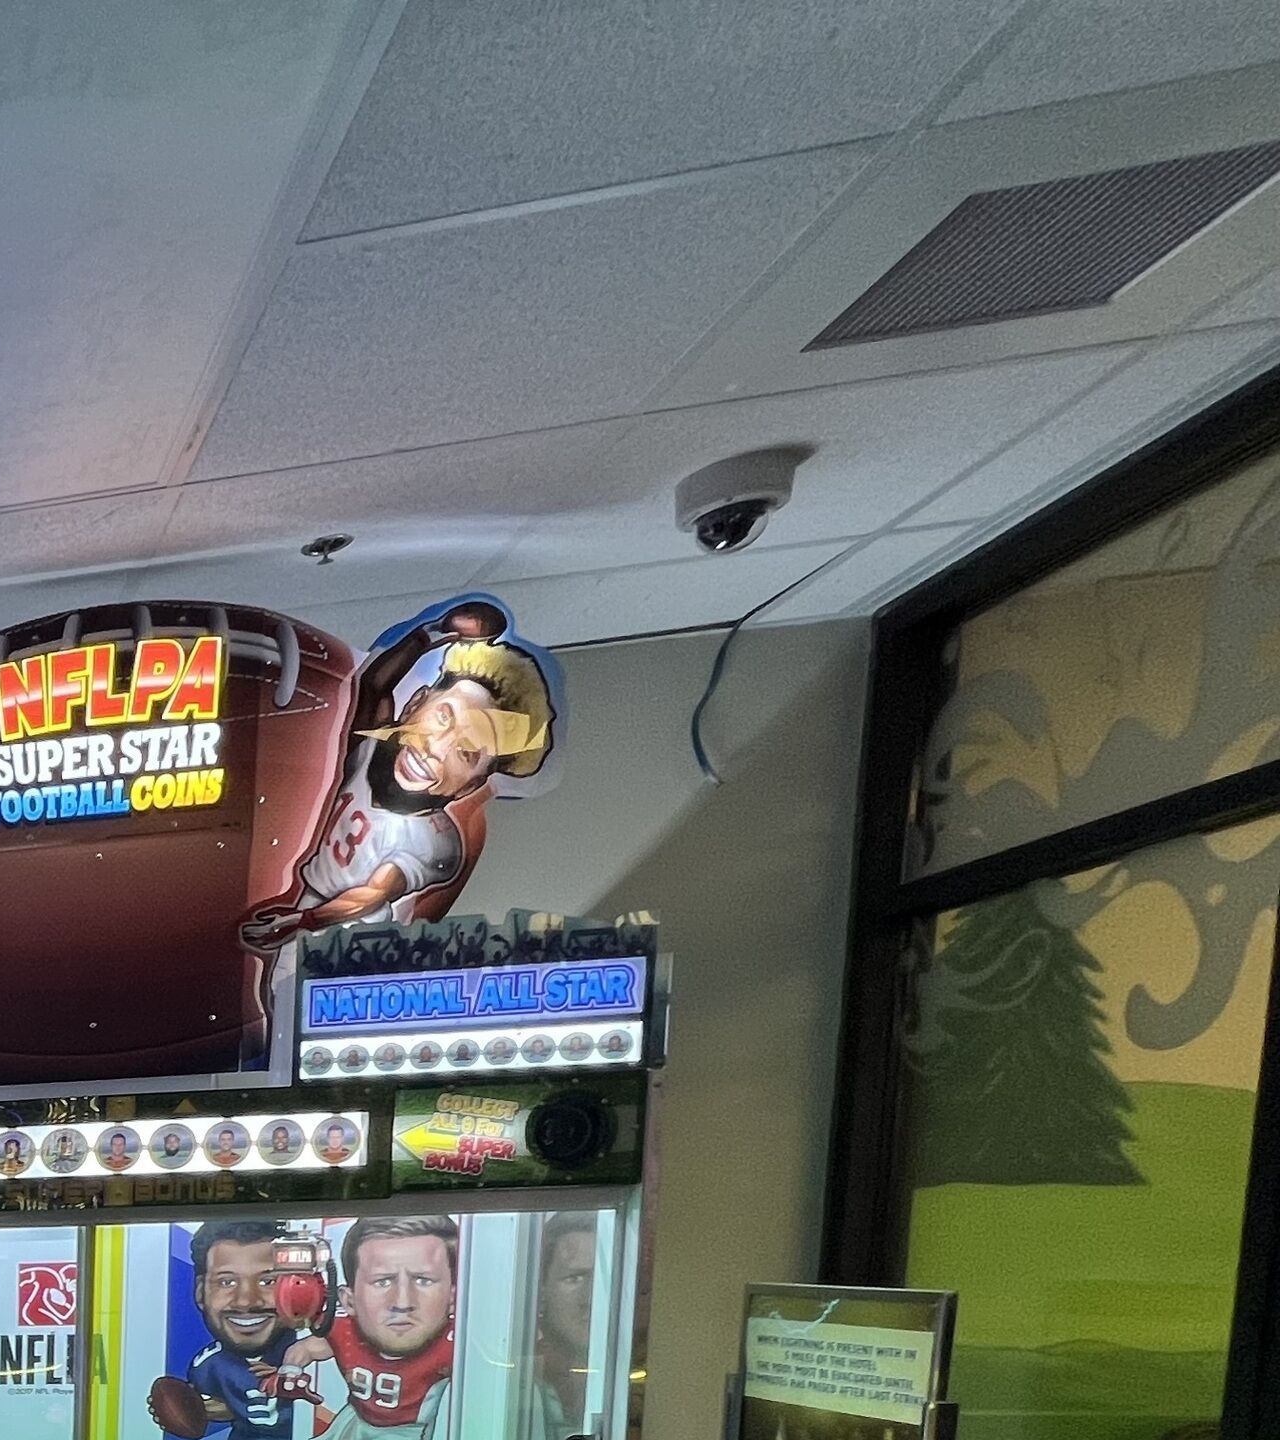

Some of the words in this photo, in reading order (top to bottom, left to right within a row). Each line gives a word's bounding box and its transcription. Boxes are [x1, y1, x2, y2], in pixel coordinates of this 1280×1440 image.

[119, 723, 222, 776] STAR
[130, 768, 225, 812] COINS
[312, 977, 465, 1024] NATIONAL
[475, 972, 539, 1012] ALL
[544, 968, 632, 1009] STAR
[437, 1093, 519, 1120] COLLECT
[458, 1135, 515, 1160] SUPER
[424, 1150, 484, 1175] BONUS
[791, 1352, 814, 1363] MILES
[816, 1354, 827, 1364] OF
[830, 1355, 845, 1367] THE
[836, 1342, 874, 1354] PRESENT
[352, 1367, 401, 1408] 99
[839, 1384, 865, 1398] AFTER
[868, 1389, 890, 1401] LAST
